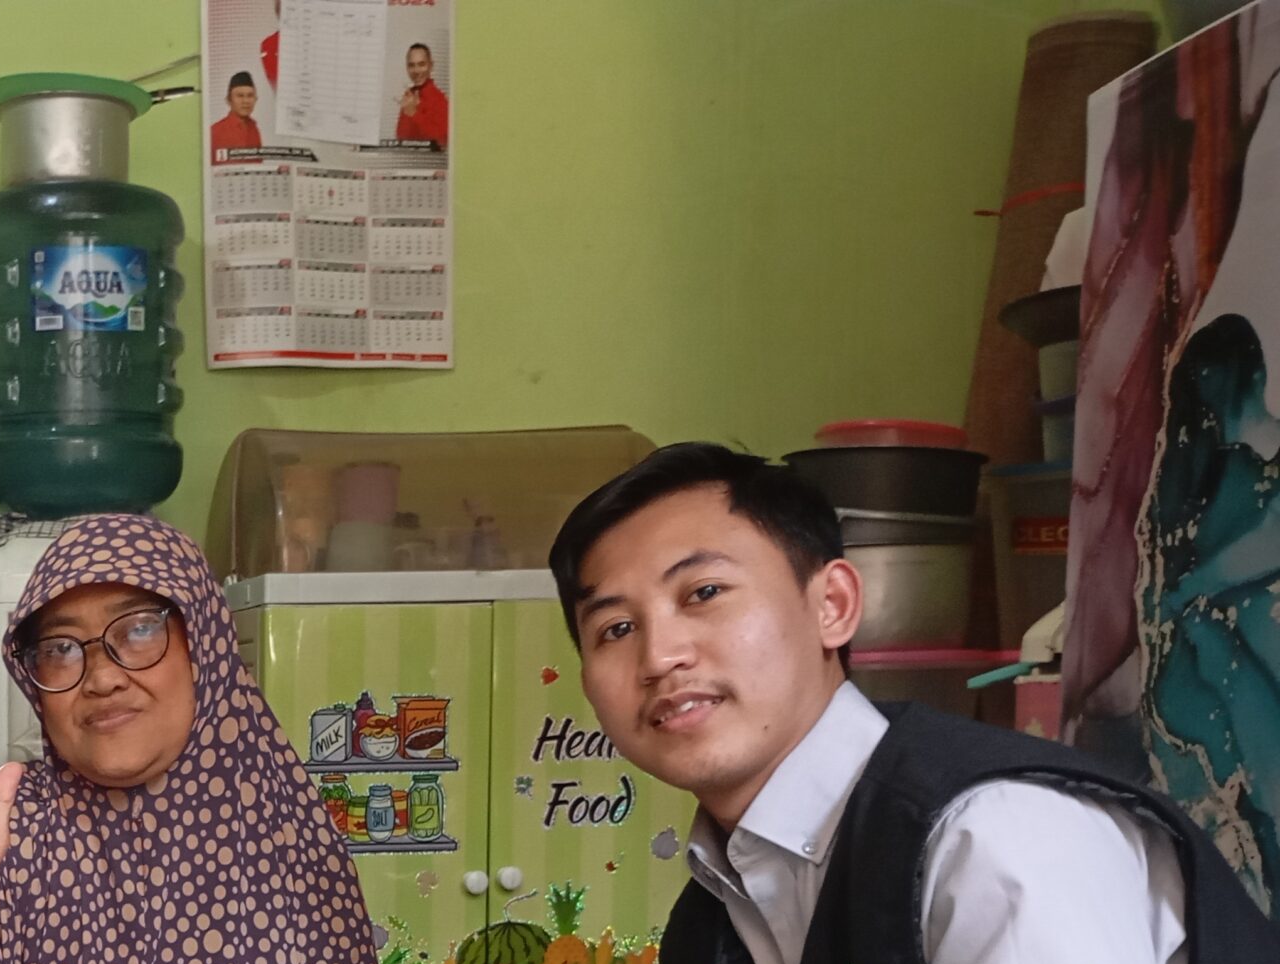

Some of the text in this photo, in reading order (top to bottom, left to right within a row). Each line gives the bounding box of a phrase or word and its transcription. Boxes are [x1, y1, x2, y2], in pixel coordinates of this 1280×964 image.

[58, 270, 124, 298] AQUA
[406, 711, 443, 732] Cereal
[315, 725, 344, 756] MILK
[543, 775, 632, 827] Food
